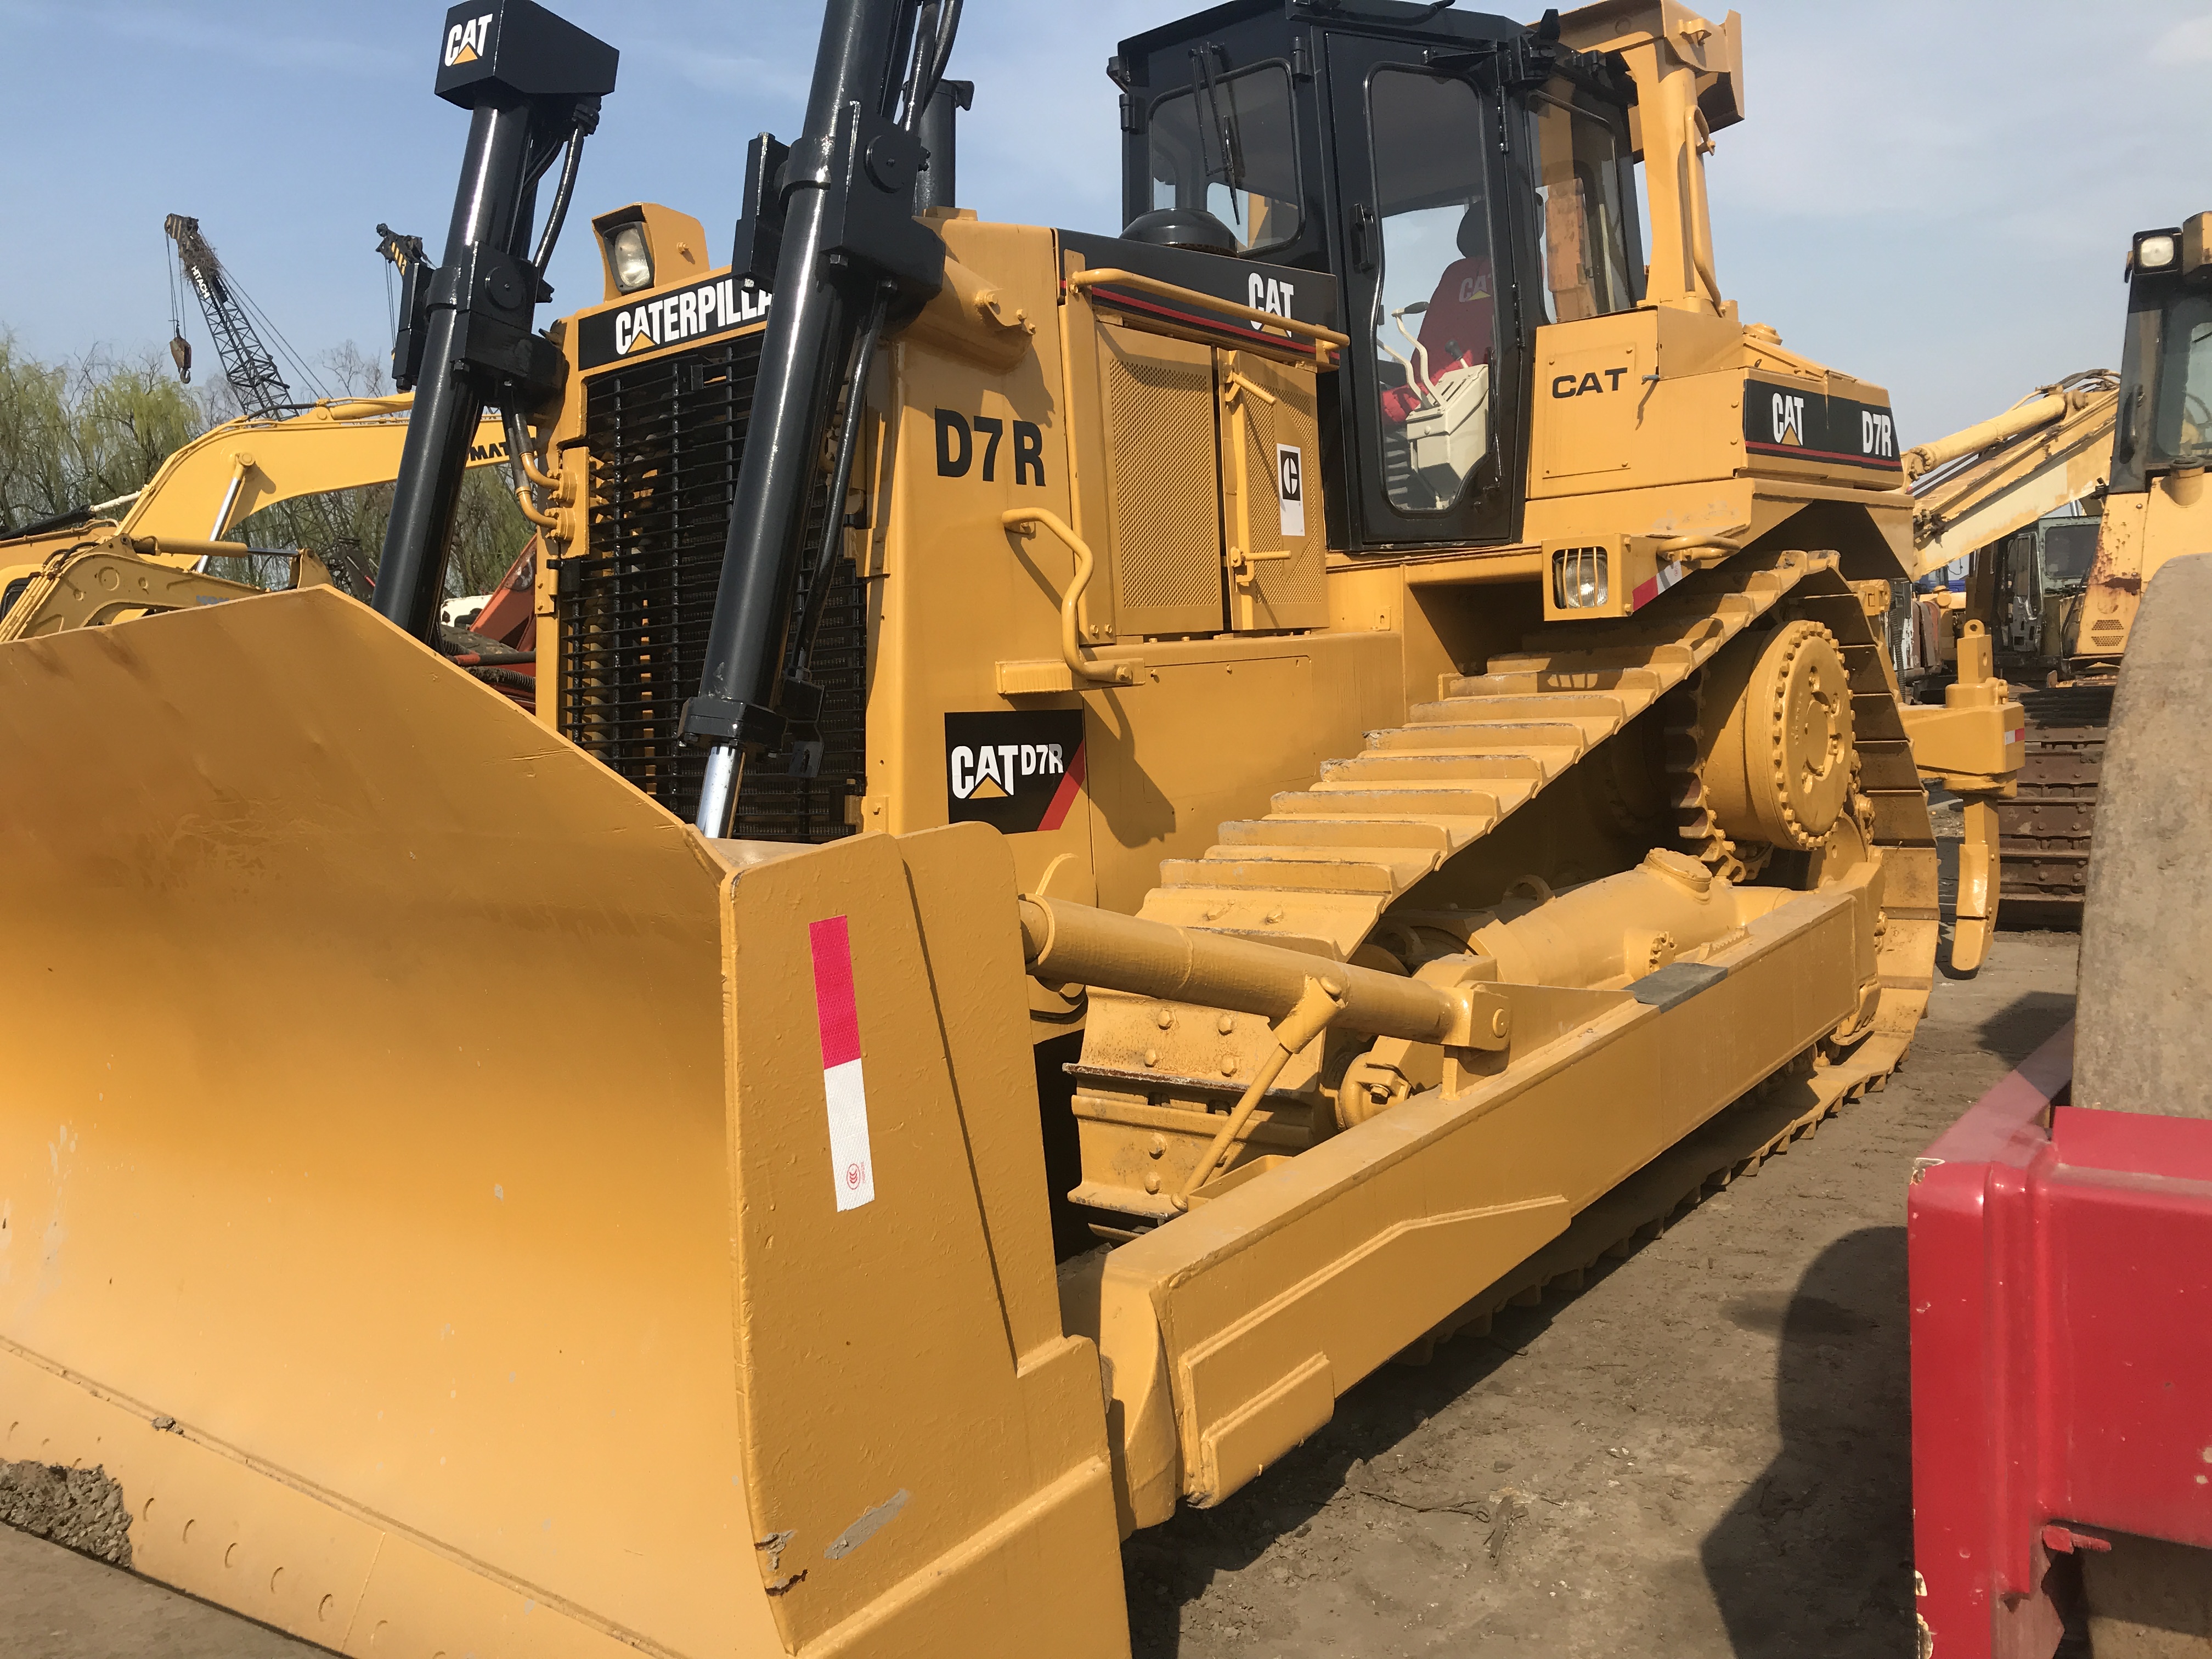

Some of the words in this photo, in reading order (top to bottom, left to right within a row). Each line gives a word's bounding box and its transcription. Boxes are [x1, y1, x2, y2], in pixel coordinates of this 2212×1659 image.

[445, 14, 493, 66] CAT
[191, 265, 210, 299] HITACHI
[1249, 272, 1294, 337] CAT
[1459, 274, 1492, 302] CA
[1552, 367, 1628, 398] CAT
[934, 408, 1046, 487] D7R
[1773, 393, 1804, 445] CAT
[1862, 410, 1892, 457] D7R
[951, 744, 1018, 799] CAT
[1020, 743, 1064, 775] D7R
